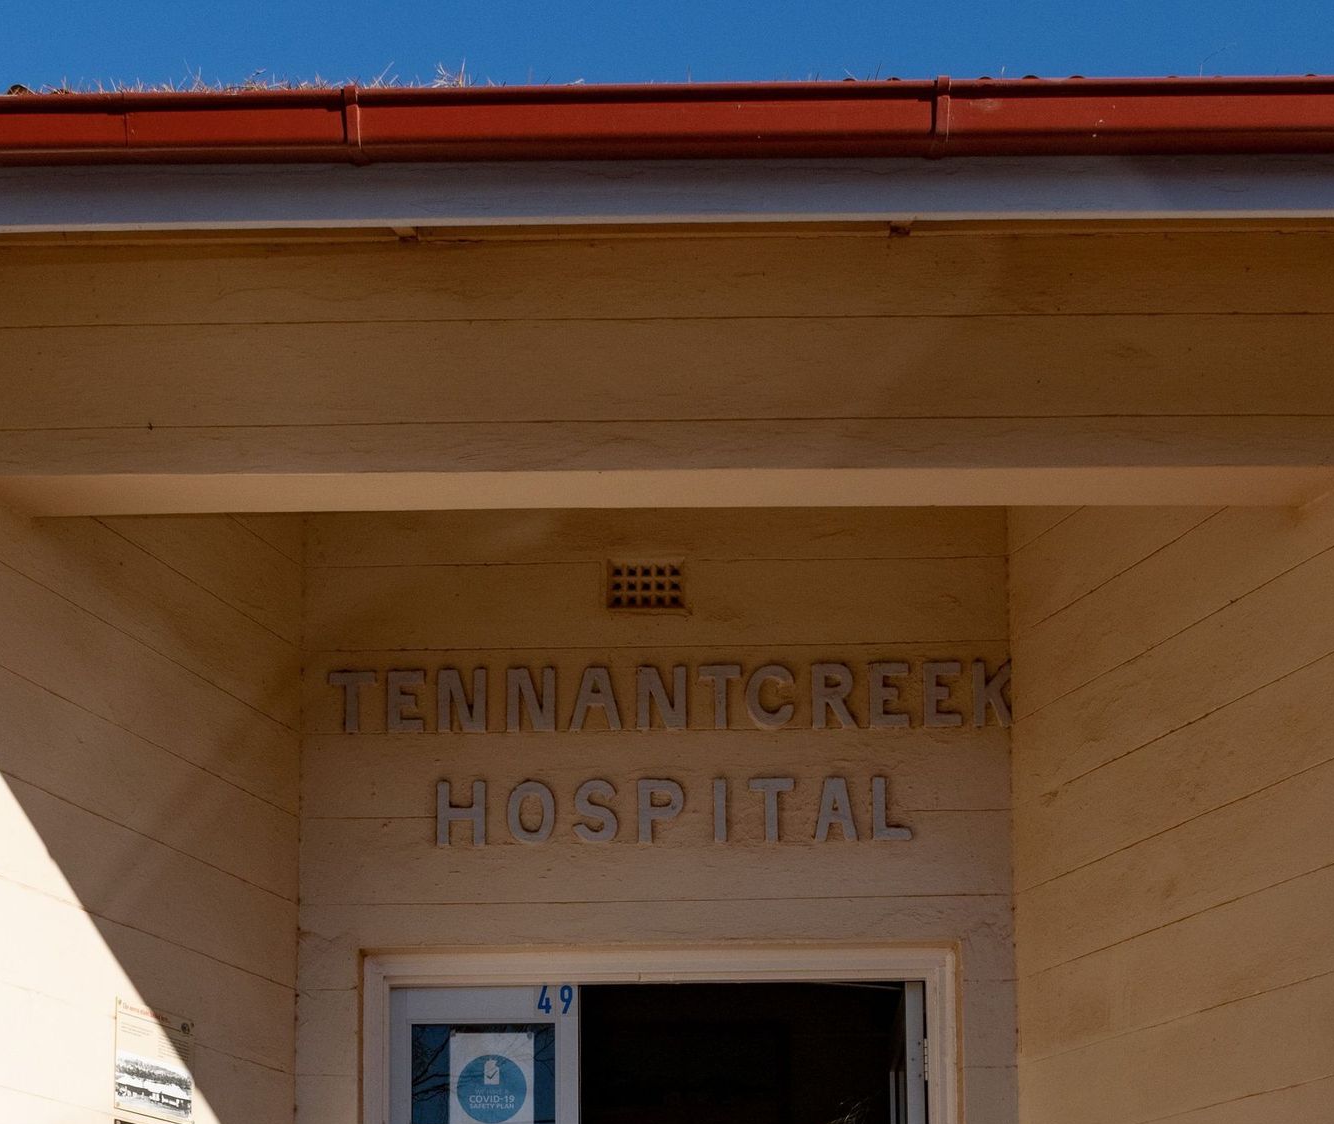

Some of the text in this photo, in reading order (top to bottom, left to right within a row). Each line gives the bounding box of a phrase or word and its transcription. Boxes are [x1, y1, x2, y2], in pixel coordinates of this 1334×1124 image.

[436, 775, 913, 847] HOSPITAL
[537, 984, 574, 1014] 49
[469, 1095, 515, 1103] COVID-19
